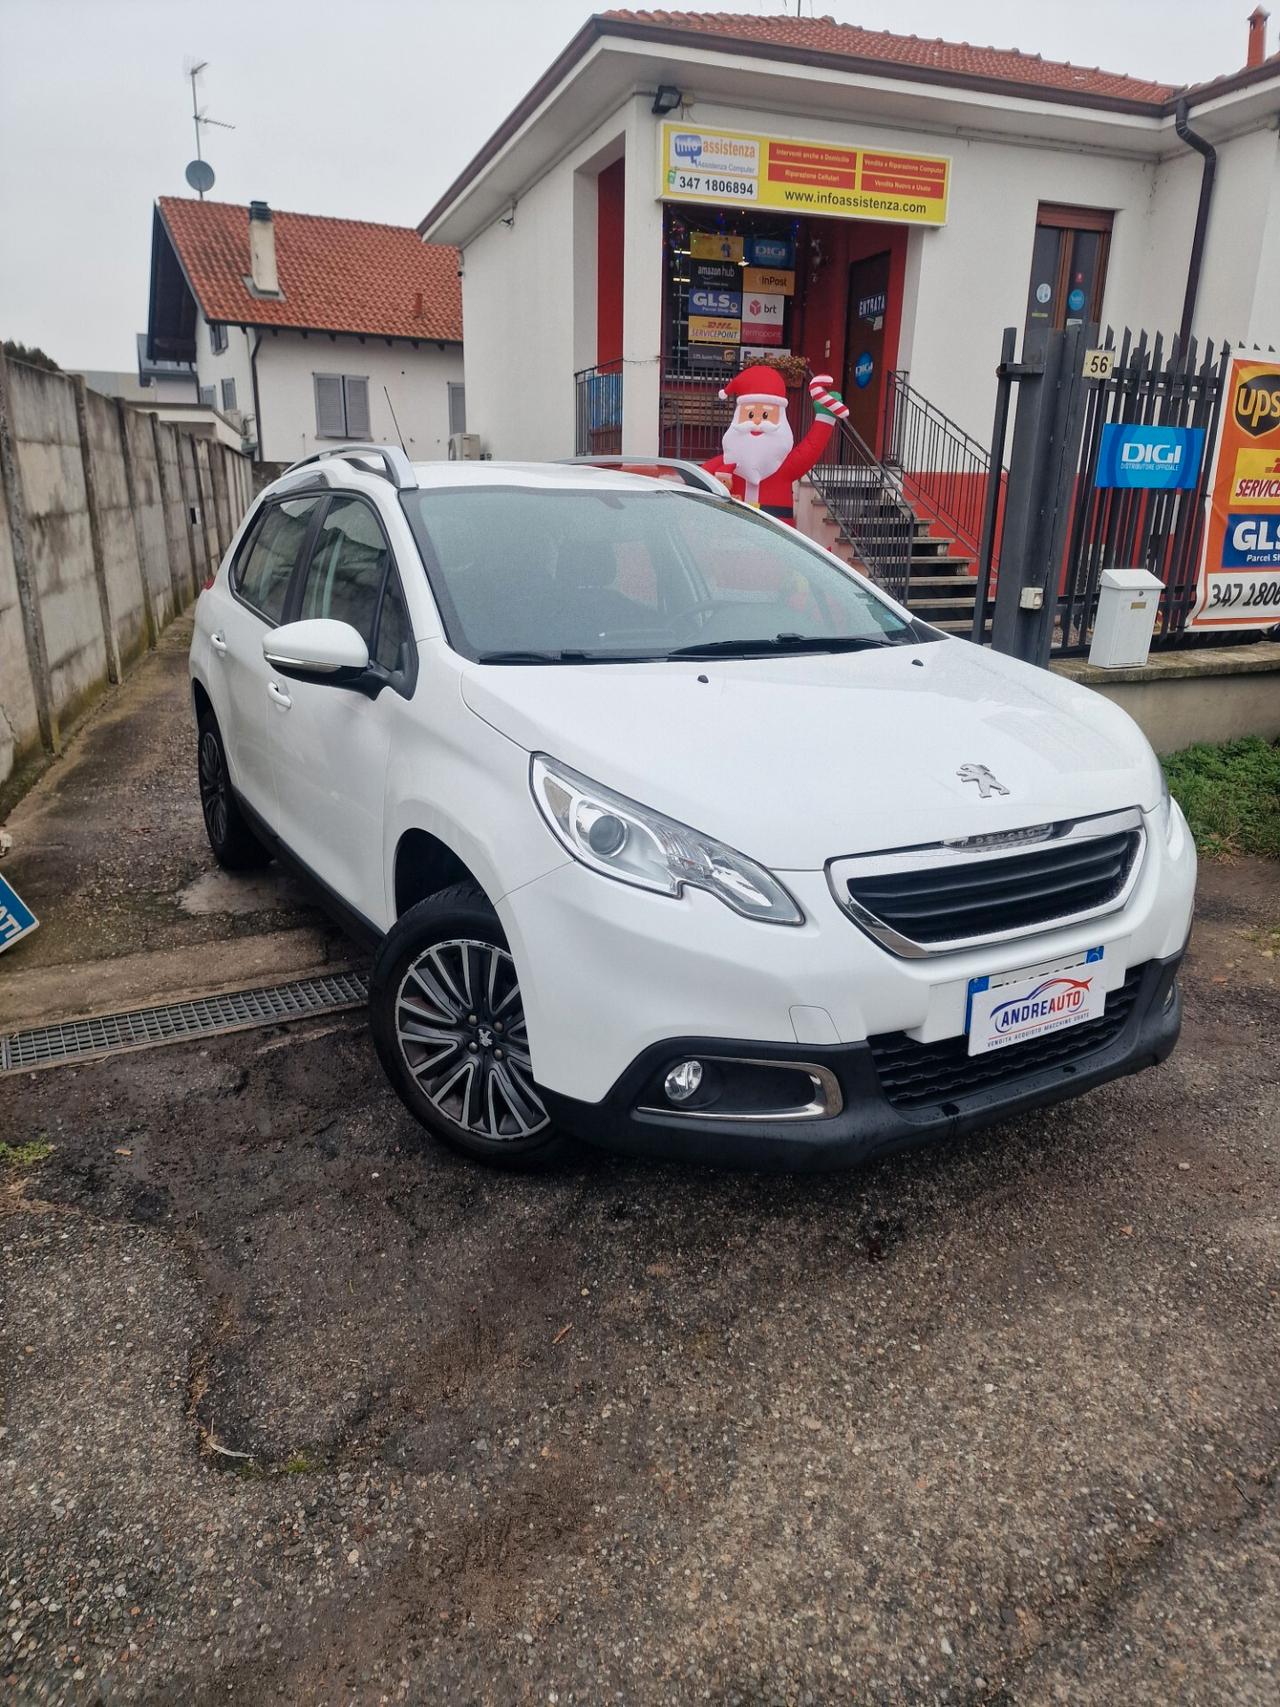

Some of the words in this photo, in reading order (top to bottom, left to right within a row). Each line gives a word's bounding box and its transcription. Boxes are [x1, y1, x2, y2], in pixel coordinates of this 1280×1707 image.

[703, 139, 755, 158] assistenza
[679, 176, 701, 190] 347
[705, 178, 754, 195] 1806894
[785, 190, 926, 214] www.infoassistenza.com
[755, 246, 785, 257] DIGI
[697, 265, 721, 276] amazon
[721, 265, 735, 278] hub
[693, 292, 730, 308] GLS
[763, 303, 777, 314] brt
[859, 295, 885, 316] ENTRATA
[706, 321, 733, 330] DHL
[855, 361, 874, 377] DIGI
[1090, 355, 1109, 373] 56
[1121, 443, 1182, 464] DIGI
[1121, 462, 1155, 471] DISTRIBUTORE
[1246, 554, 1271, 562] Parcel
[1209, 583, 1243, 608] 347
[1001, 991, 1081, 1028] ANDREAUTO
[987, 1037, 1012, 1048] VENDITA
[1014, 1029, 1042, 1039] ACQUISTO
[1044, 1018, 1071, 1031] MACCHINE
